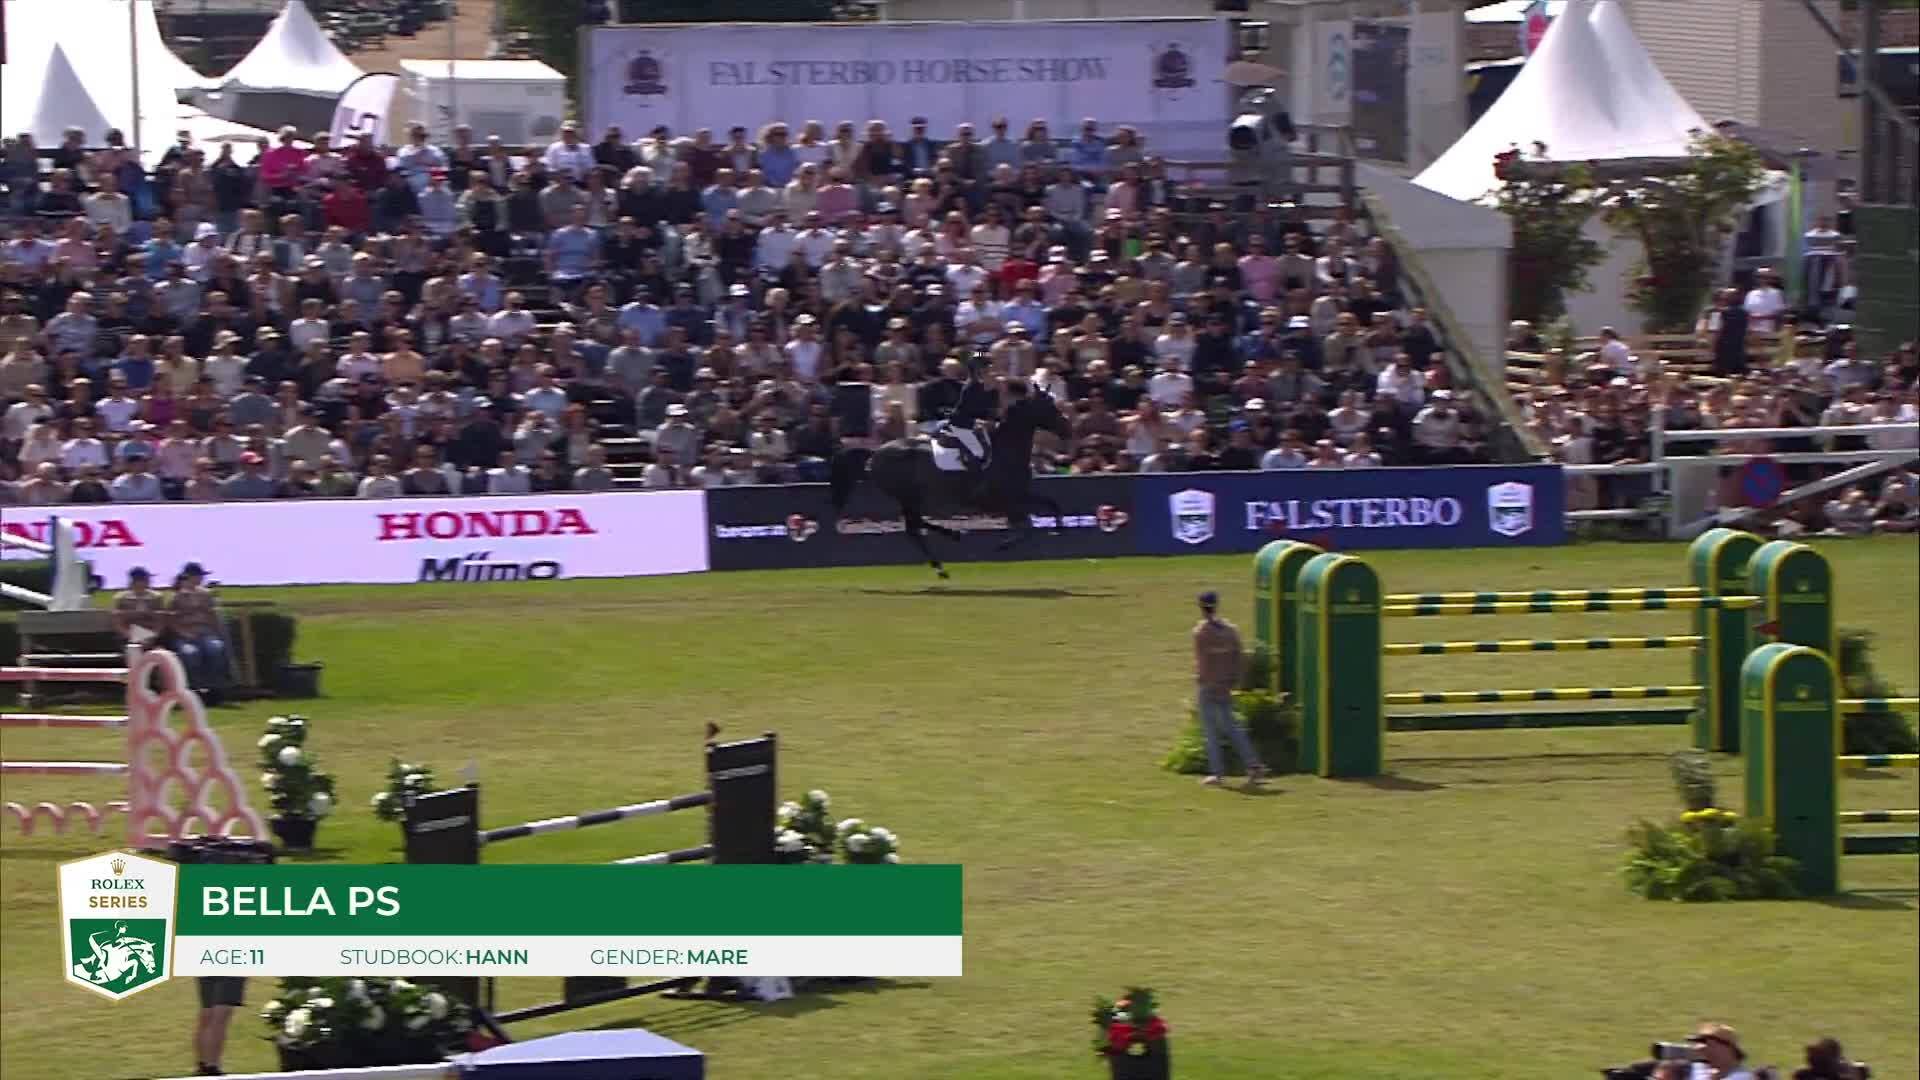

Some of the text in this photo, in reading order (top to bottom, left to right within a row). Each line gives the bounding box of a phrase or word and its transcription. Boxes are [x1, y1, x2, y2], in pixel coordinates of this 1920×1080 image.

[710, 56, 1113, 87] FALSTERBO HORSE SHOW
[376, 508, 597, 543] HONDA
[1244, 497, 1461, 530] FALSTERBO
[418, 551, 561, 581] Miimo
